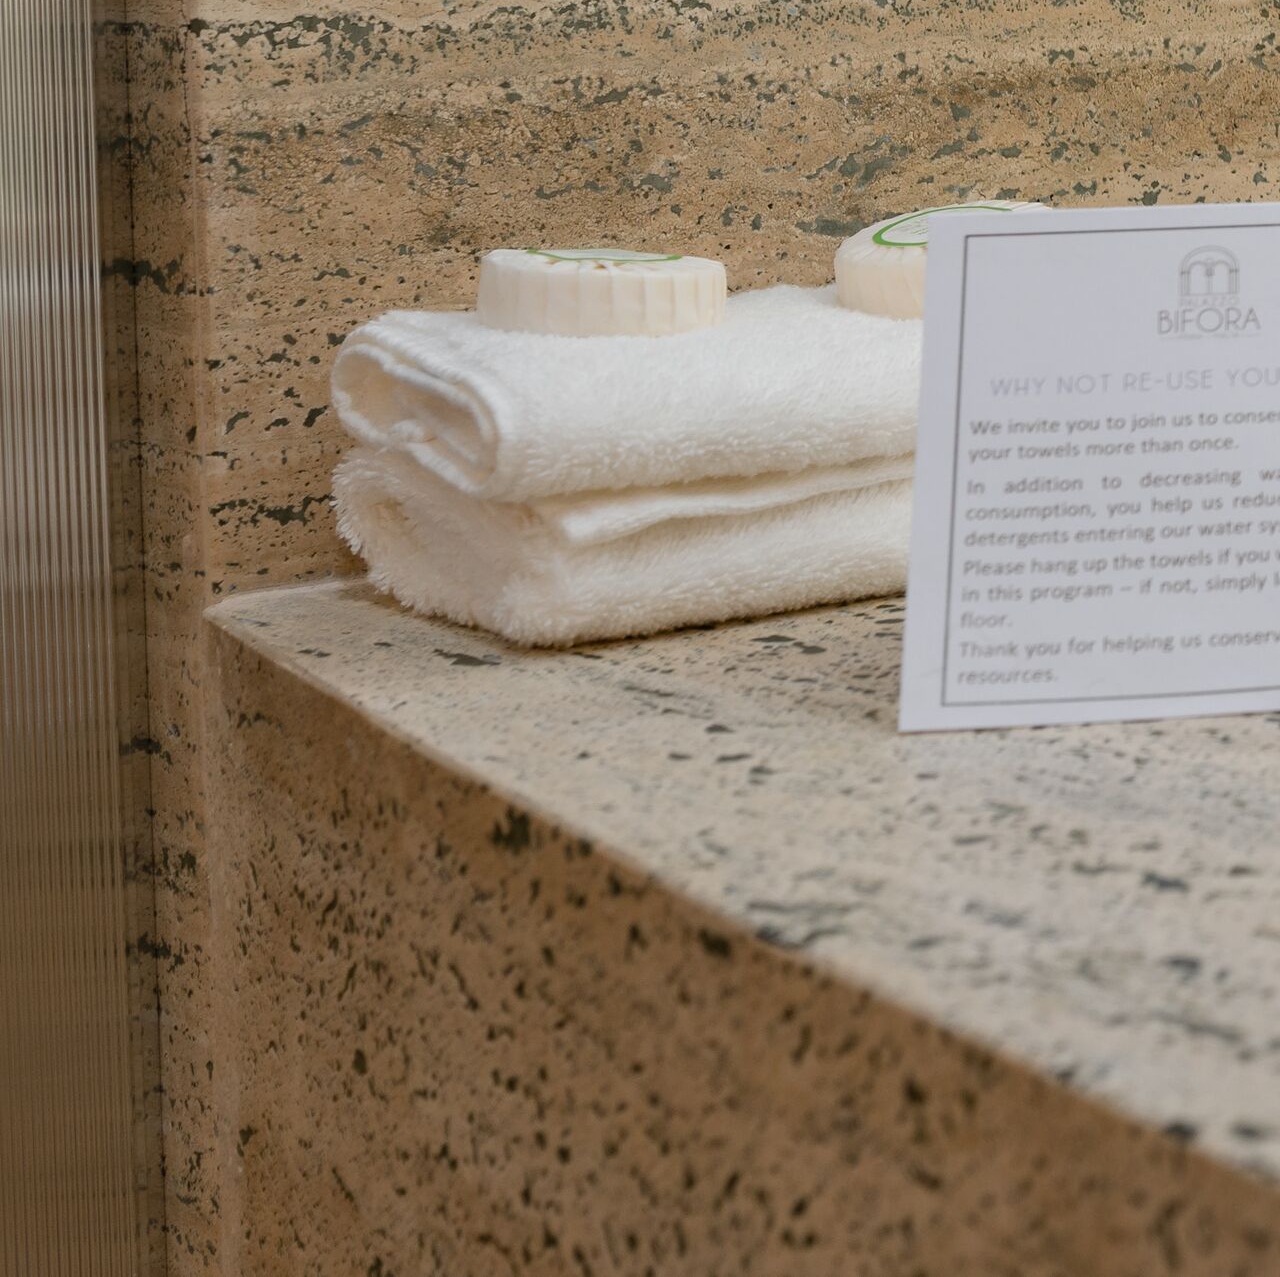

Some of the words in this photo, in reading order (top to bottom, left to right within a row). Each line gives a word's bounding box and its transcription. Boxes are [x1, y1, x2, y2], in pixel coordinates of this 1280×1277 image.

[1157, 307, 1262, 335] BIFORA
[990, 376, 1045, 398] WHY
[1057, 373, 1110, 396] NOT
[1123, 369, 1214, 393] RE-USE
[970, 420, 1002, 435] We
[1008, 420, 1060, 434] invite
[1065, 420, 1100, 436] you
[1106, 415, 1125, 431] to
[1130, 415, 1167, 433] join
[1172, 415, 1193, 427] us
[1198, 411, 1218, 426] to
[968, 448, 1011, 464] your
[1018, 442, 1080, 460] towels
[1085, 442, 1135, 456] more
[1141, 437, 1183, 453] than
[1189, 437, 1239, 452] once.
[966, 480, 985, 495] In
[1003, 476, 1083, 494] addition
[1102, 475, 1122, 490] to
[1140, 469, 1241, 489] decreasing
[965, 502, 1096, 522] consumption,
[1107, 502, 1142, 518] you
[1151, 496, 1193, 514] help
[1202, 497, 1223, 511] us
[964, 530, 1069, 549] detergents
[1074, 525, 1155, 544] entering
[1160, 524, 1193, 539] our
[1198, 520, 1253, 537] water
[963, 559, 1025, 575] Please
[1030, 556, 1078, 575] hang
[1083, 558, 1108, 573] up
[1112, 554, 1145, 571] the
[1151, 549, 1213, 568] towels
[1217, 548, 1231, 564] if
[1236, 549, 1270, 566] you
[962, 587, 979, 601] in
[987, 584, 1023, 600] this
[1030, 584, 1113, 604] program
[1139, 578, 1152, 594] if
[1159, 577, 1198, 595] not,
[1205, 573, 1267, 593] simply
[960, 612, 1013, 628] floor.
[959, 641, 1018, 658] Thank
[1025, 642, 1061, 660] you
[1067, 636, 1095, 655] for
[1102, 634, 1174, 655] helping
[1180, 634, 1202, 648] us
[956, 668, 1058, 686] resources.
